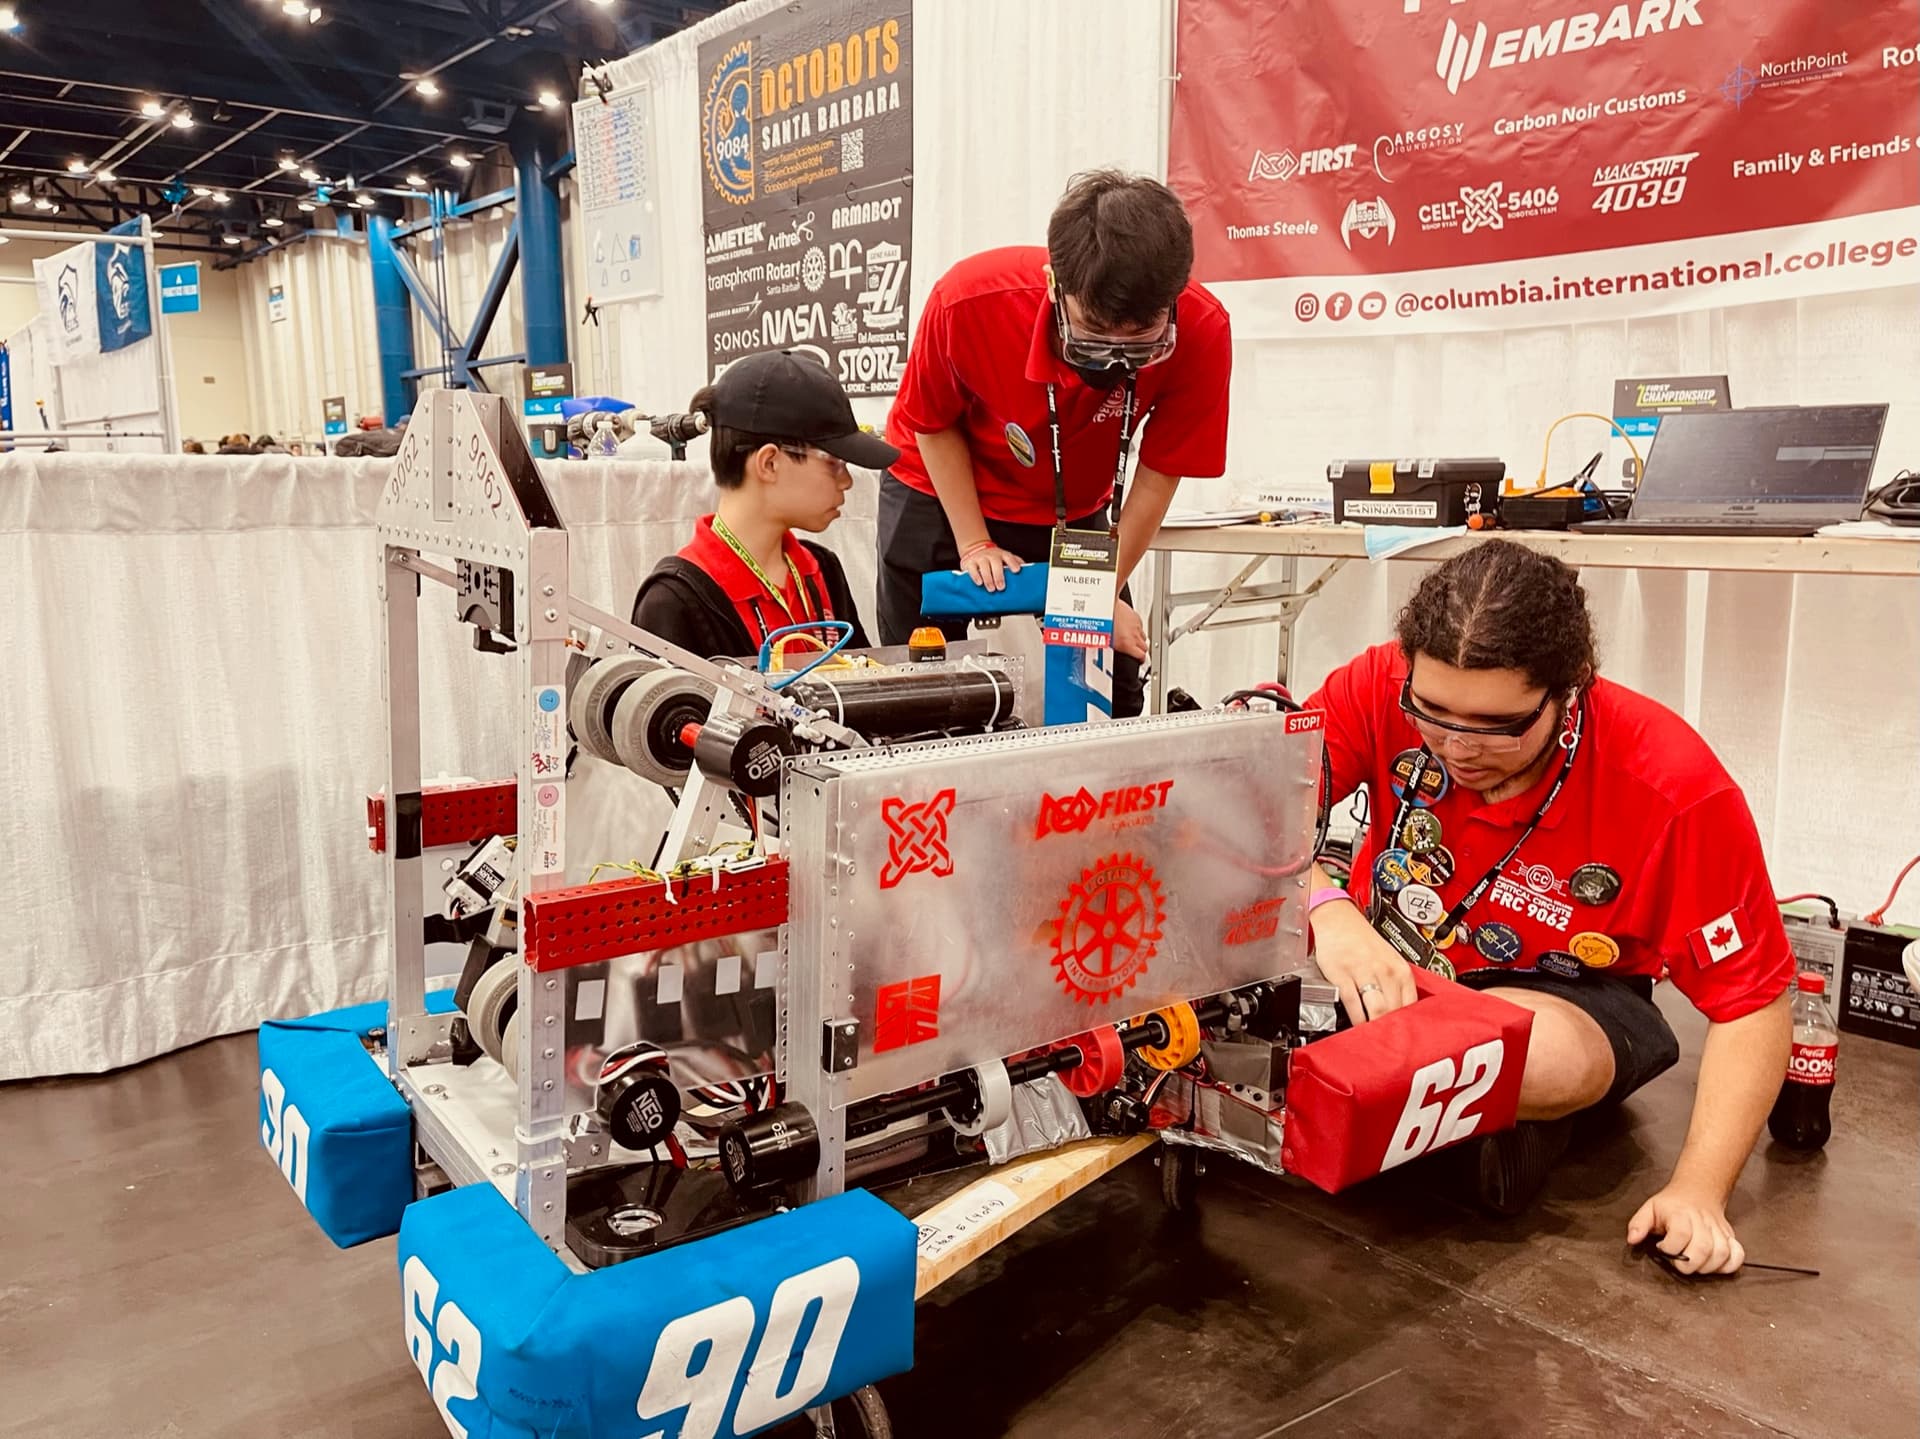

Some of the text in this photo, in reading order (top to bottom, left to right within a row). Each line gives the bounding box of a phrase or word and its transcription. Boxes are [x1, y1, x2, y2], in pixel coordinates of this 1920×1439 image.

[1489, 0, 1704, 69] EMBARK
[761, 19, 900, 116] OCTOBOTS
[1760, 50, 1848, 78] NorthPoint
[761, 82, 900, 151] SANTA BARBARA
[1493, 89, 1687, 136] Carbon Noir Customs
[716, 134, 749, 161] 9084
[1395, 122, 1464, 146] ARGOSY
[1298, 143, 1357, 176] FIRST
[1592, 152, 1700, 187] MAKESHIFT
[1733, 135, 1911, 178] Family & Friends
[832, 197, 902, 229] ARMABOT
[1592, 176, 1688, 214] 4039
[706, 222, 765, 254] AMETEK
[1226, 219, 1319, 241] Thomas Steele
[1395, 236, 1918, 317] @columbia.international.college
[714, 329, 760, 351] SONOS
[762, 302, 828, 345] NASA
[838, 345, 900, 381] STORZ
[1643, 389, 1716, 401] CHAMPIONSHIP
[392, 433, 418, 504] 9062
[469, 434, 502, 520] 9062
[1361, 504, 1434, 516] NINJASSIST
[1063, 575, 1101, 585] WILBERT
[1063, 631, 1106, 646] CANADA
[1289, 716, 1320, 731] STOP!
[748, 745, 783, 780] NEO
[1099, 780, 1174, 820] FIRST
[1532, 871, 1549, 885] CC
[1490, 887, 1569, 932] FRC 9062
[1495, 880, 1571, 918] CRITICAL CIRCUITS
[1790, 1056, 1833, 1072] 100%
[636, 1090, 663, 1129] NEO
[1380, 1039, 1504, 1173] 62
[262, 1068, 310, 1207] 90
[404, 1255, 483, 1439] 62
[636, 1255, 862, 1439] 90
